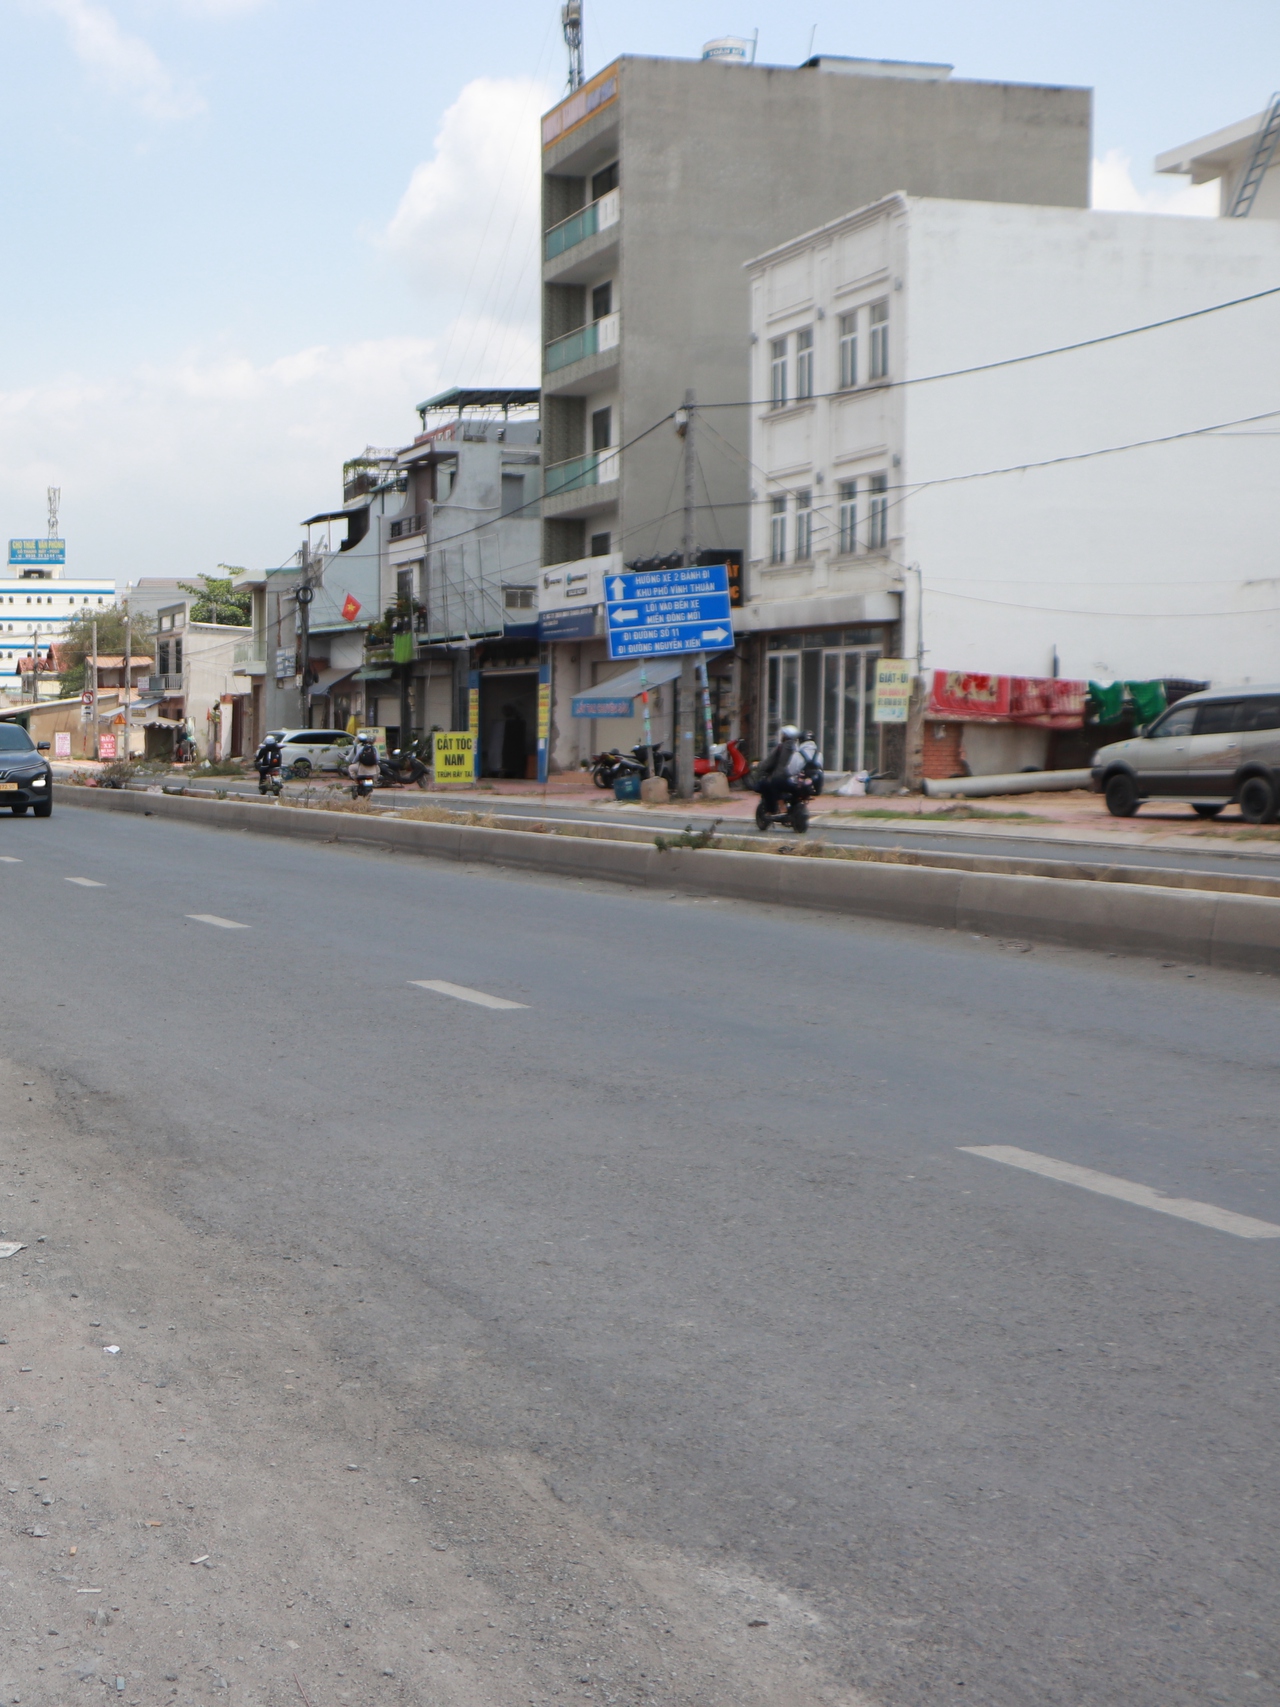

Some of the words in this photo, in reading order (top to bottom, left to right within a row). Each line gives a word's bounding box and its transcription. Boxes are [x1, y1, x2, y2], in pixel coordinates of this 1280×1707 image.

[635, 573, 661, 585] HƯỚNG
[663, 573, 672, 582] XE
[674, 572, 679, 581] 2
[680, 570, 701, 581] BÁNH
[702, 569, 710, 579] ĐI
[636, 587, 652, 597] KHU
[653, 583, 669, 595] PHỐ
[690, 581, 716, 592] THUẬN
[674, 598, 689, 609] BẾN
[690, 599, 700, 608] XE
[666, 611, 686, 622] ĐÔNG
[687, 609, 701, 620] MỚI
[623, 632, 632, 641] ĐI
[633, 628, 658, 640] ĐƯỜNG
[660, 626, 670, 637] SỐ
[672, 628, 680, 637] 11
[618, 645, 626, 654] ĐI
[628, 641, 653, 653] ĐƯỜNG
[437, 734, 453, 750] CẮT
[456, 735, 472, 750] TÓC
[445, 753, 465, 766] NAM
